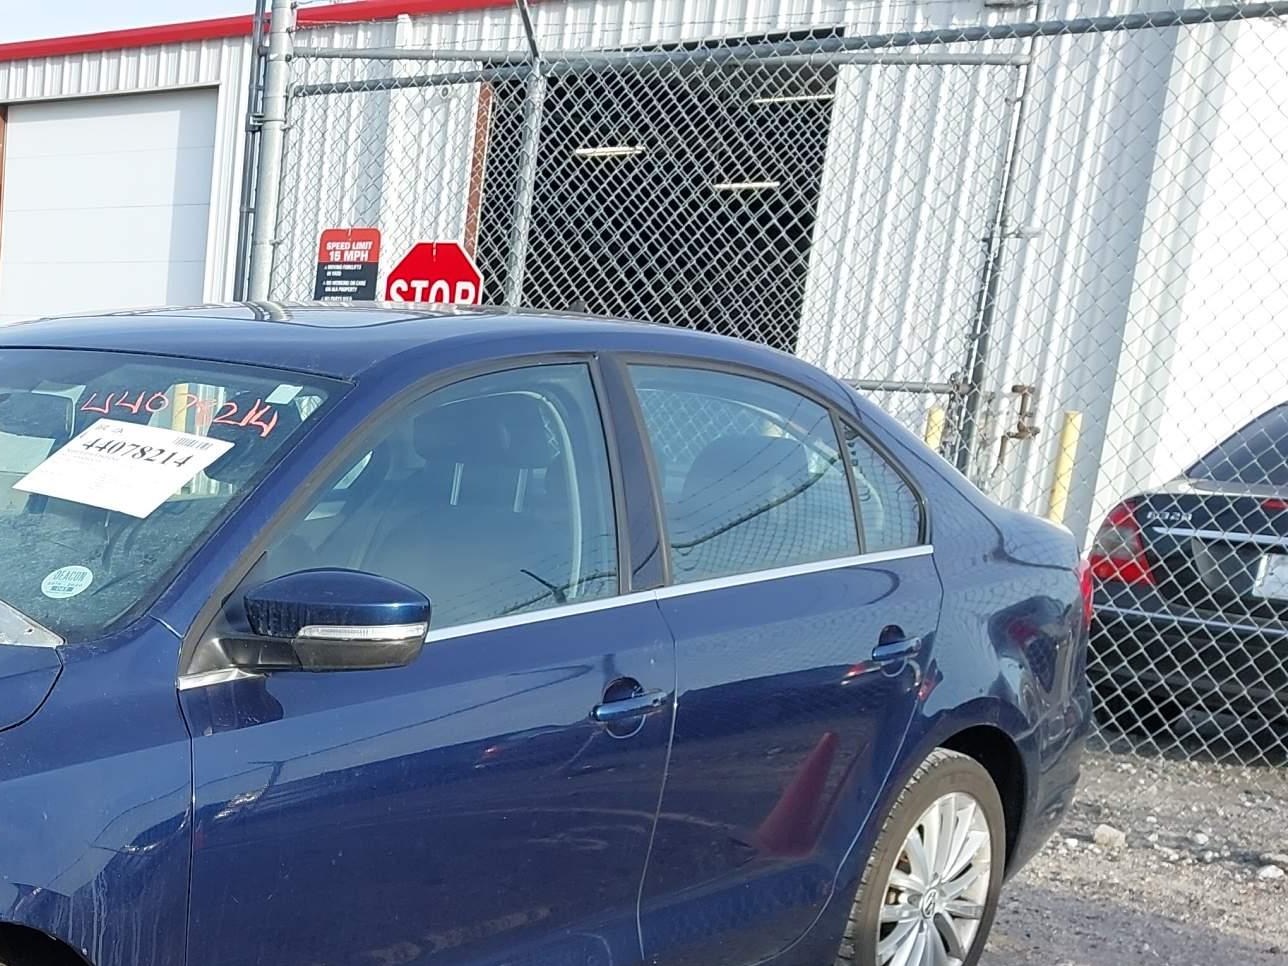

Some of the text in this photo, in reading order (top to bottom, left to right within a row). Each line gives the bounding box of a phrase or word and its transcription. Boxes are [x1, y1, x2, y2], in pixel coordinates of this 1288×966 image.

[326, 241, 373, 250] SPEED LIMIT
[343, 250, 369, 261] MPH
[390, 279, 475, 304] STOP
[82, 437, 194, 468] 44078214
